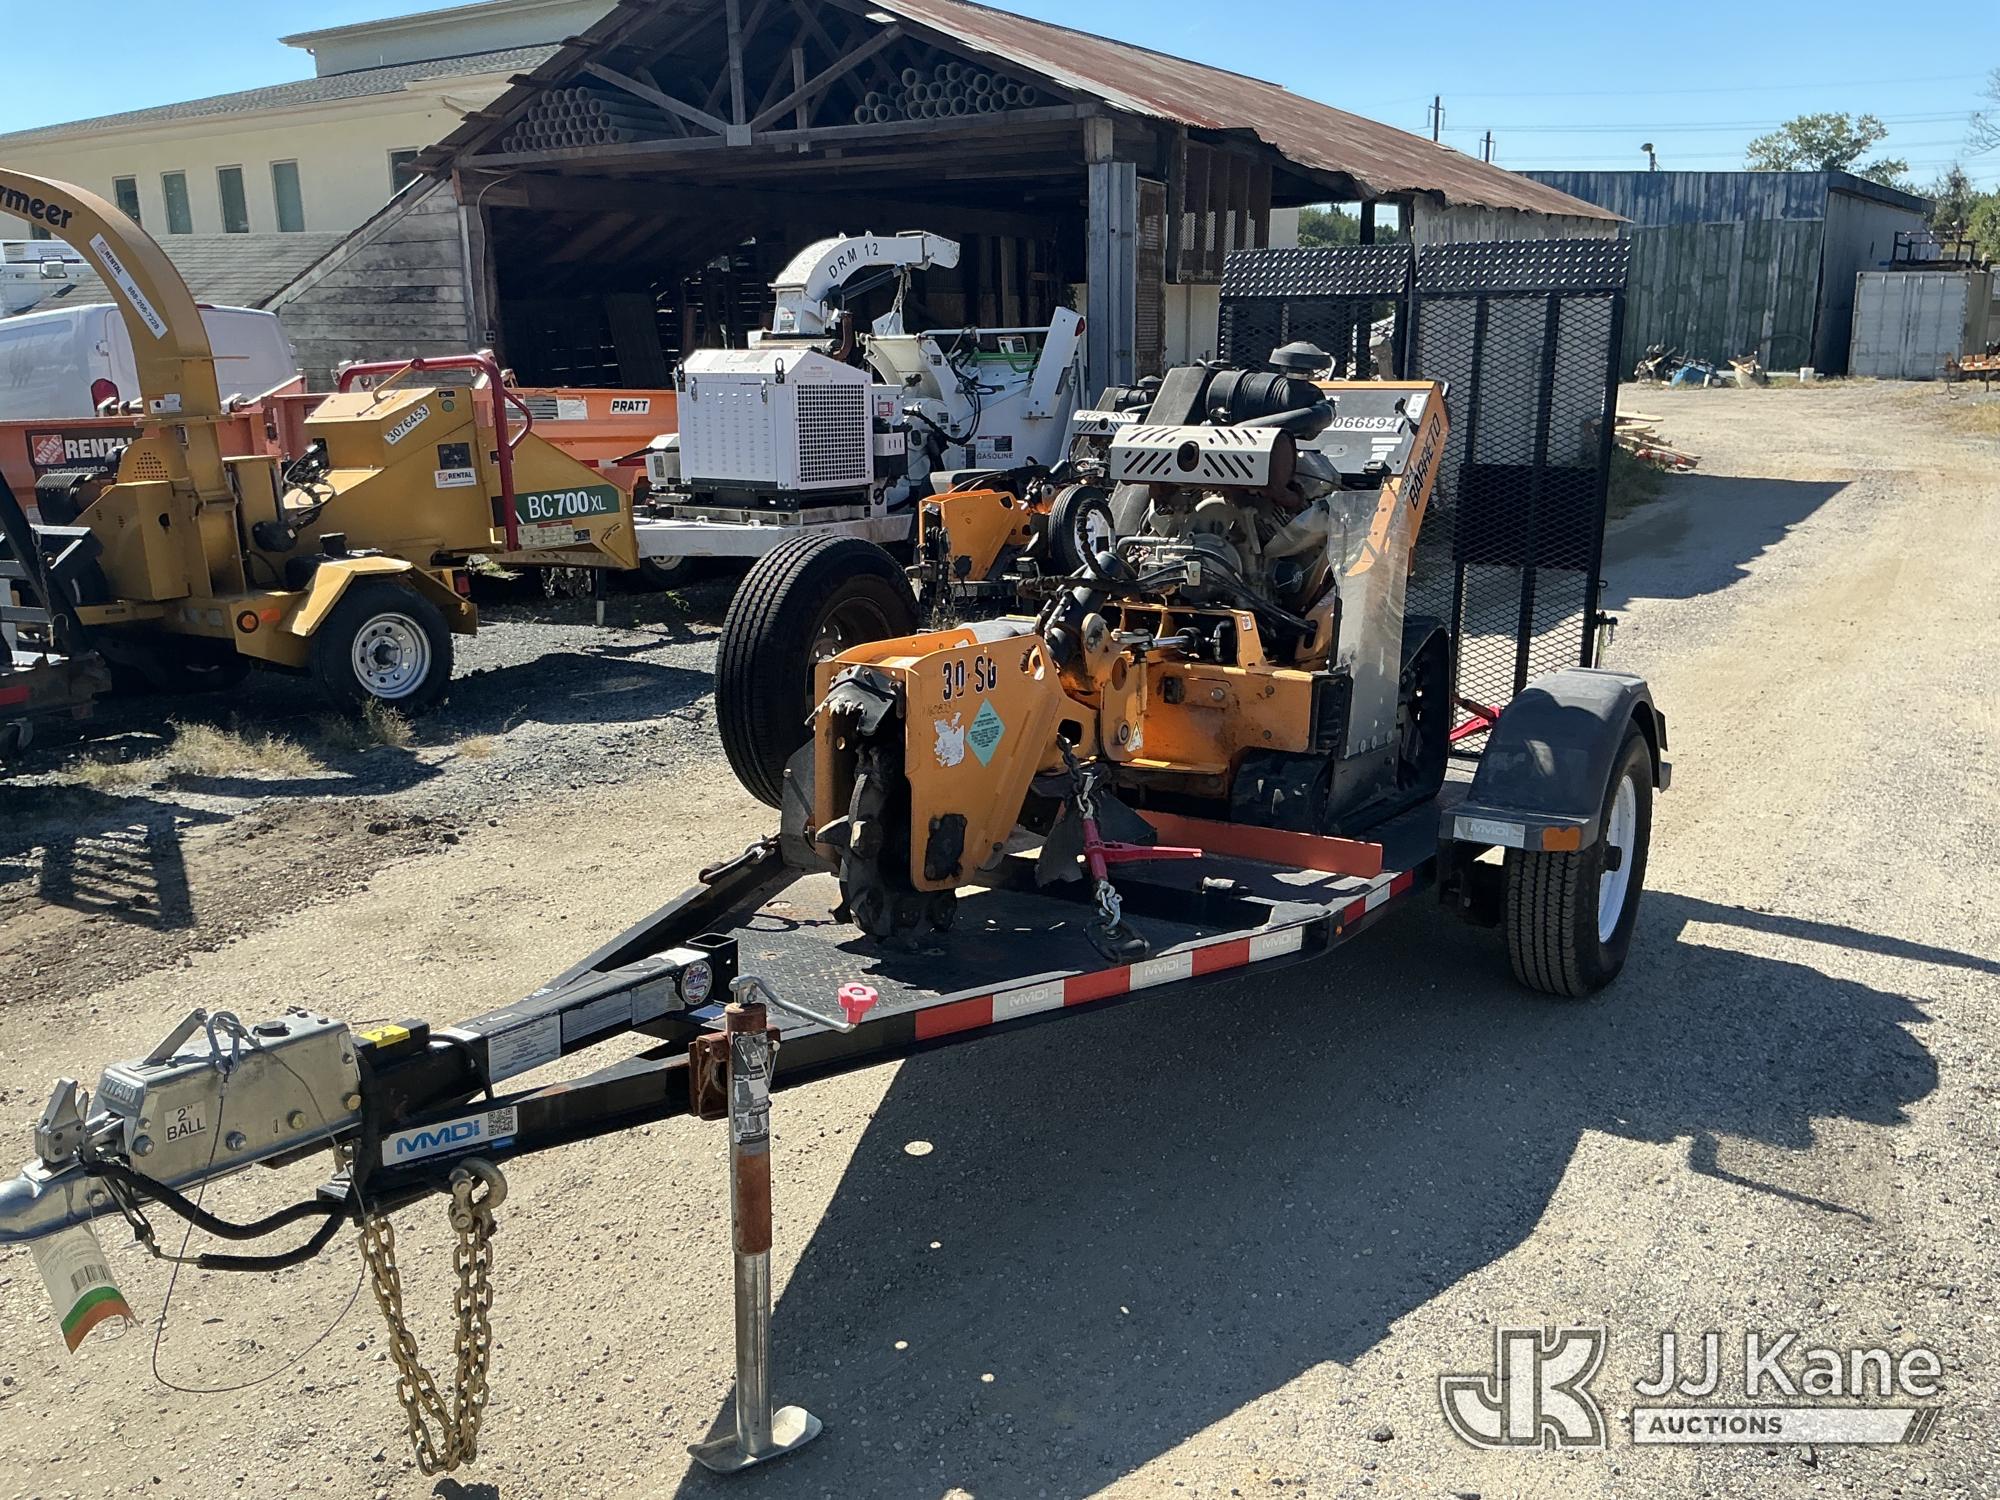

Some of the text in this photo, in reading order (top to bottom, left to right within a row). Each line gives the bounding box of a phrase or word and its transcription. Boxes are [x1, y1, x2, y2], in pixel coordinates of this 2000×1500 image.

[104, 250, 122, 275] RENTAL
[828, 242, 879, 279] DRM 12
[611, 400, 648, 412] PRATT
[387, 405, 429, 442] 3076453
[976, 452, 1014, 460] GASOLINE
[1409, 412, 1441, 511] BARRETO
[447, 471, 473, 480] RENTAL
[167, 1118, 206, 1141] BALL
